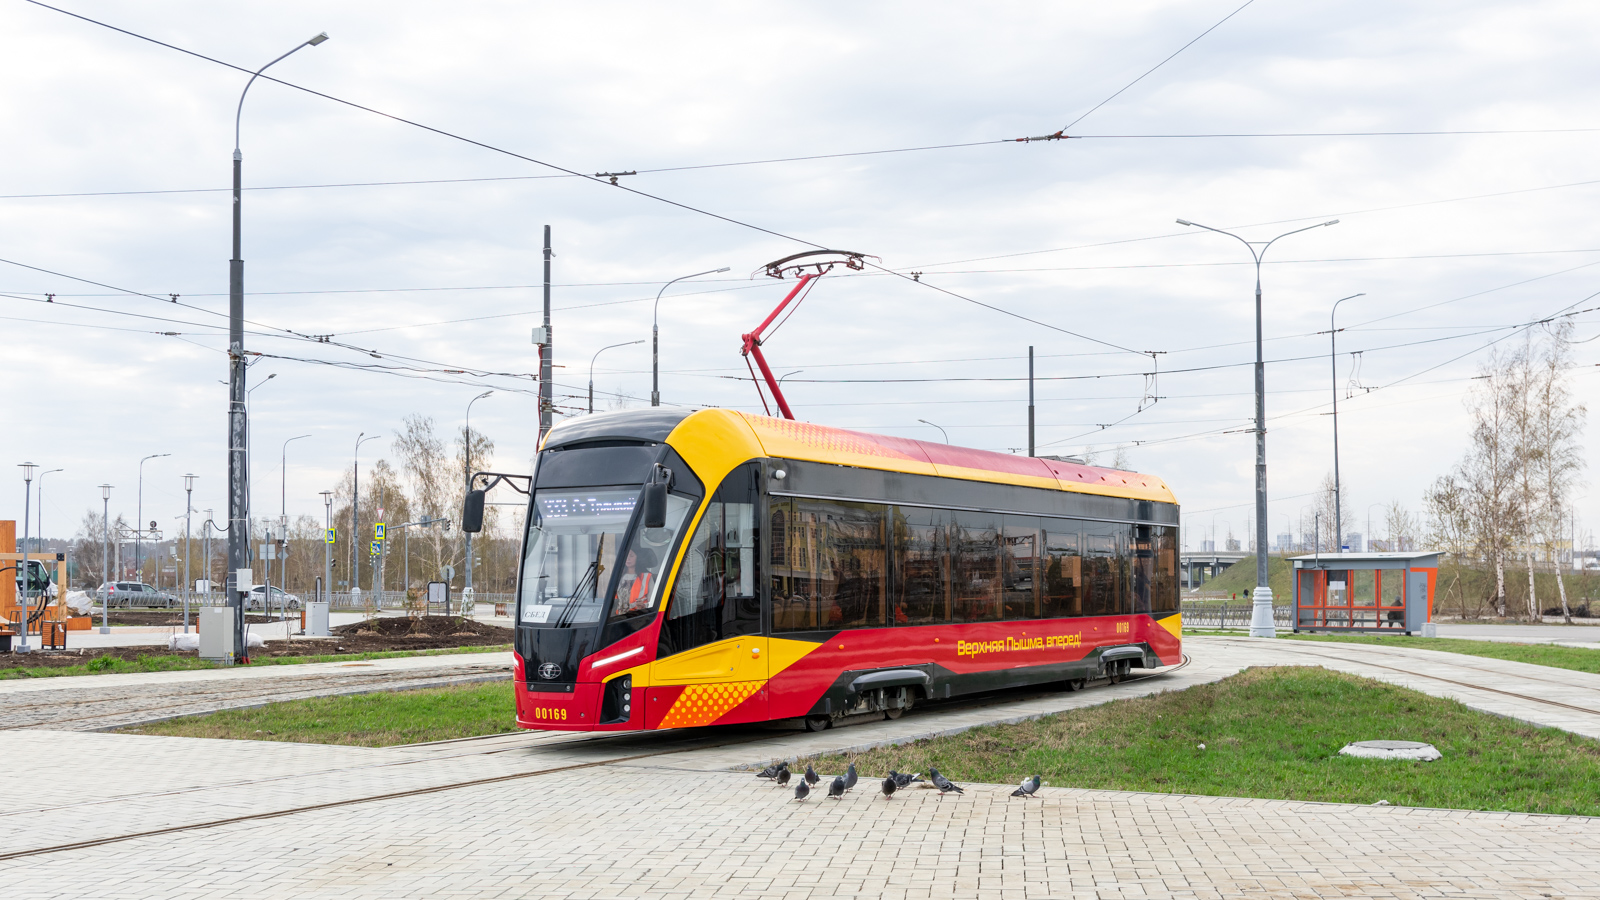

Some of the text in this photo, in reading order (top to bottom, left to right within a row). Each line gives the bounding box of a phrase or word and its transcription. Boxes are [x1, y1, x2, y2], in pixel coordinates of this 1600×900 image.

[1116, 621, 1129, 634] 00169
[957, 631, 1082, 659] Верхняя Пышма, вперед!
[535, 707, 567, 720] 00169
